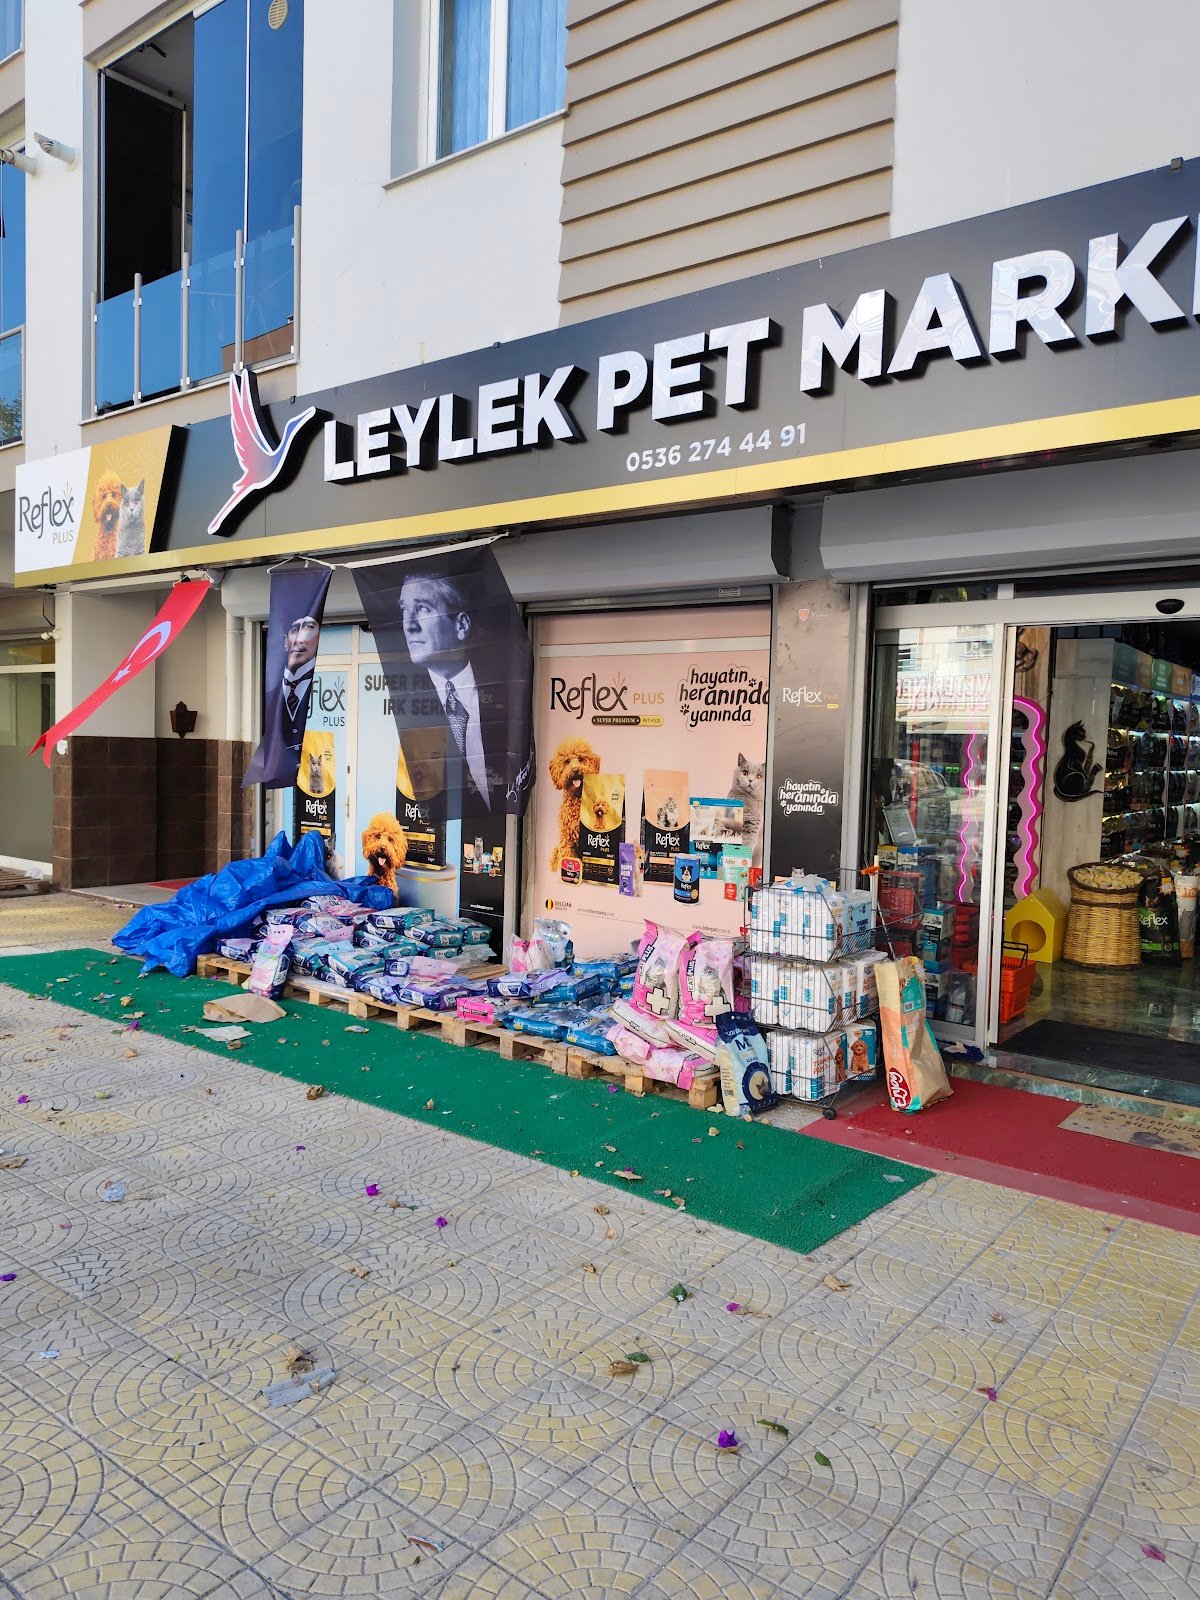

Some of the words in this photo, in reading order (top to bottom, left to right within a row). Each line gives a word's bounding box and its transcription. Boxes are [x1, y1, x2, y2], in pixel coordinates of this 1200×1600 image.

[324, 364, 575, 482] LEYLEK
[596, 317, 770, 430] PET
[800, 213, 1200, 393] MARK
[626, 445, 682, 472] 0536
[688, 436, 732, 463] 274
[738, 429, 772, 453] 44
[779, 423, 807, 448] 91
[19, 484, 75, 540] Reflex
[52, 530, 75, 545] PLUS
[690, 668, 748, 690] hayatın
[306, 675, 346, 719] flex
[549, 671, 629, 720] Reflex
[633, 692, 665, 705] PLUS
[679, 683, 706, 702] her
[782, 685, 823, 707] Reflex
[323, 716, 346, 727] PLUS
[689, 704, 752, 728] yanında
[786, 780, 821, 793] hayatın
[785, 803, 823, 815] yanında
[587, 833, 610, 849] Reflex
[655, 832, 681, 849] Reflex
[643, 944, 655, 962] PLUS
[889, 1071, 908, 1109] Enjoy
